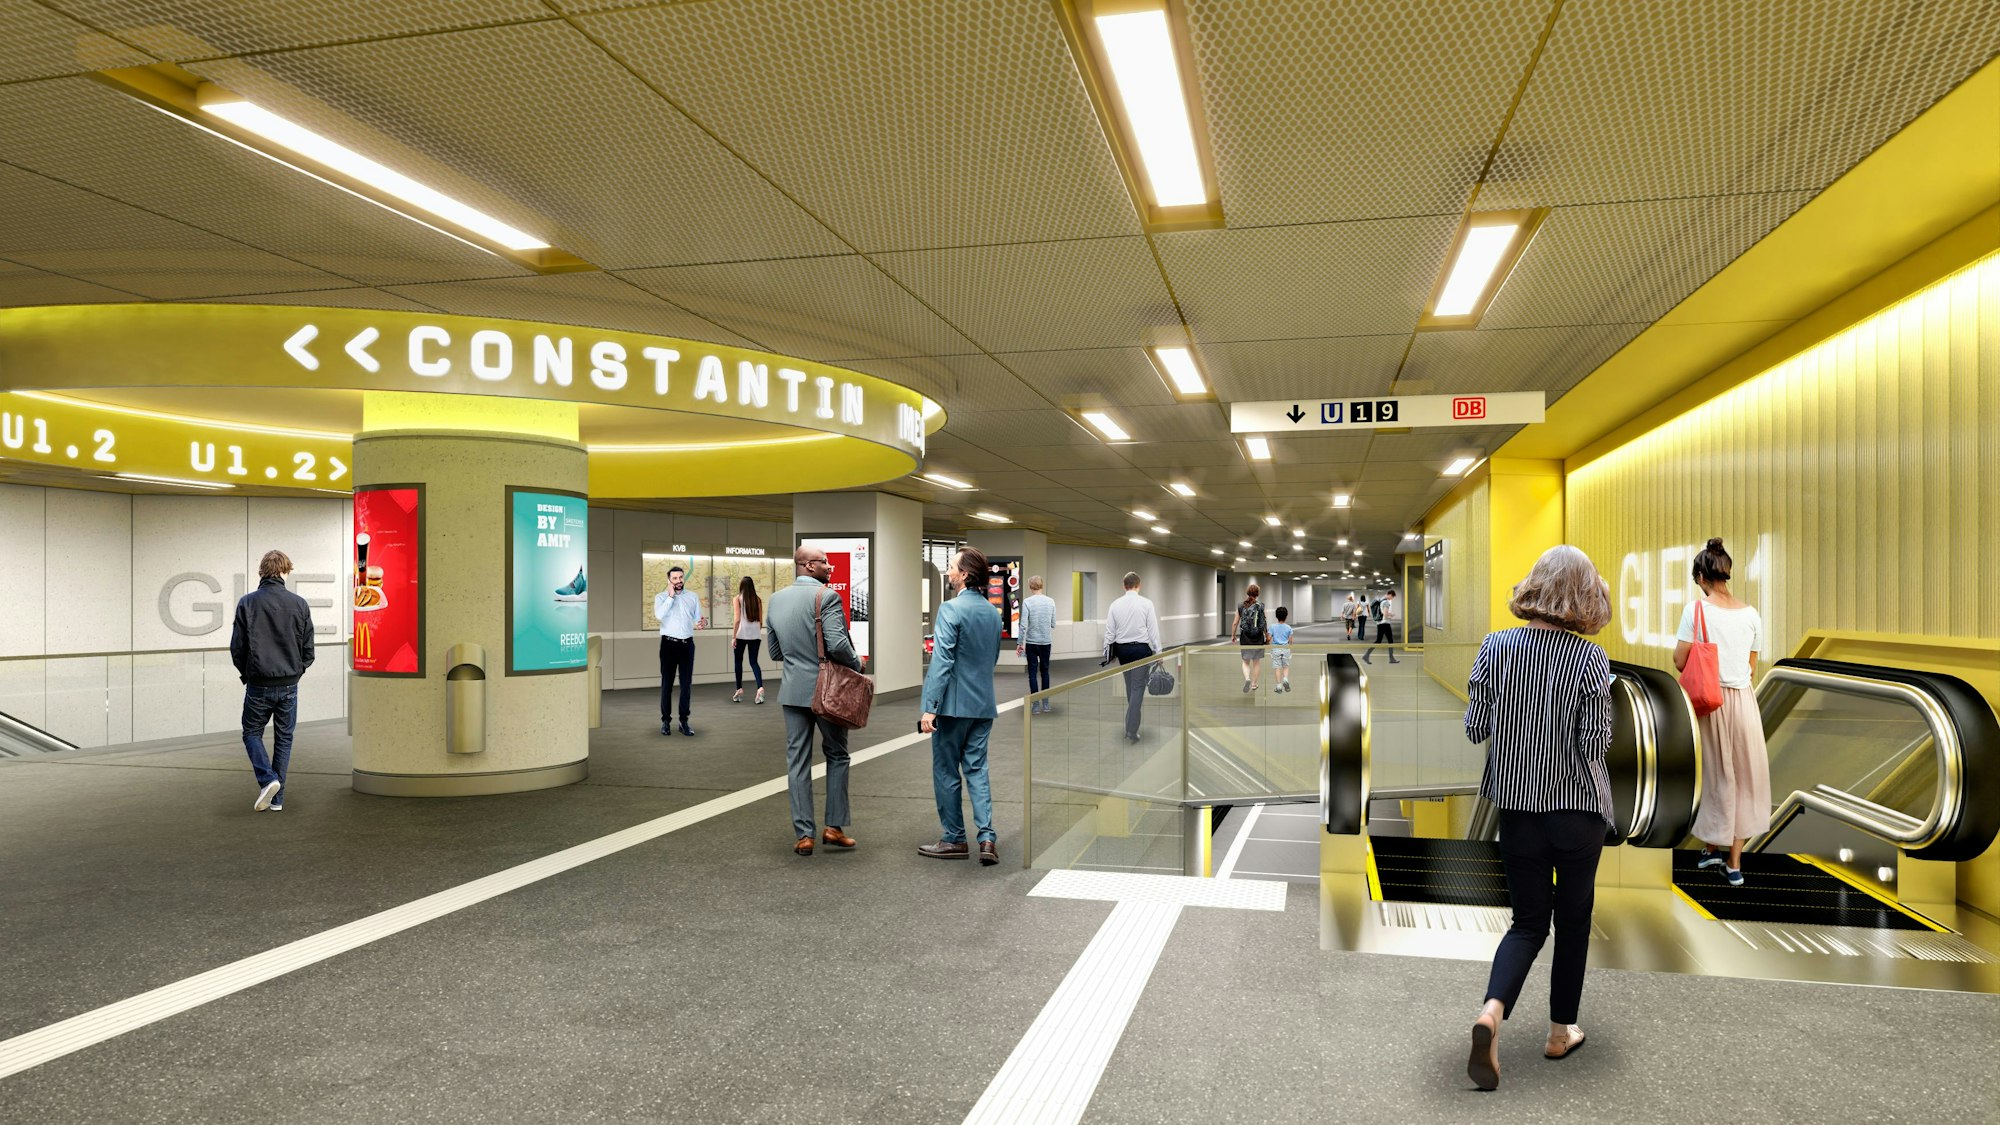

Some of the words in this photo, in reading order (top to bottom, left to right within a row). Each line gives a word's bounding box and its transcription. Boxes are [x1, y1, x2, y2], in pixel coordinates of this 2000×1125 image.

[408, 325, 863, 426] CONSTANTIN
[1456, 400, 1482, 416] DB
[1, 412, 117, 462] U1.2
[537, 504, 564, 514] DESIGN
[537, 515, 557, 530] BY
[537, 533, 571, 548] AMIT
[672, 544, 687, 552] KVB
[725, 547, 765, 556] INFORMATION
